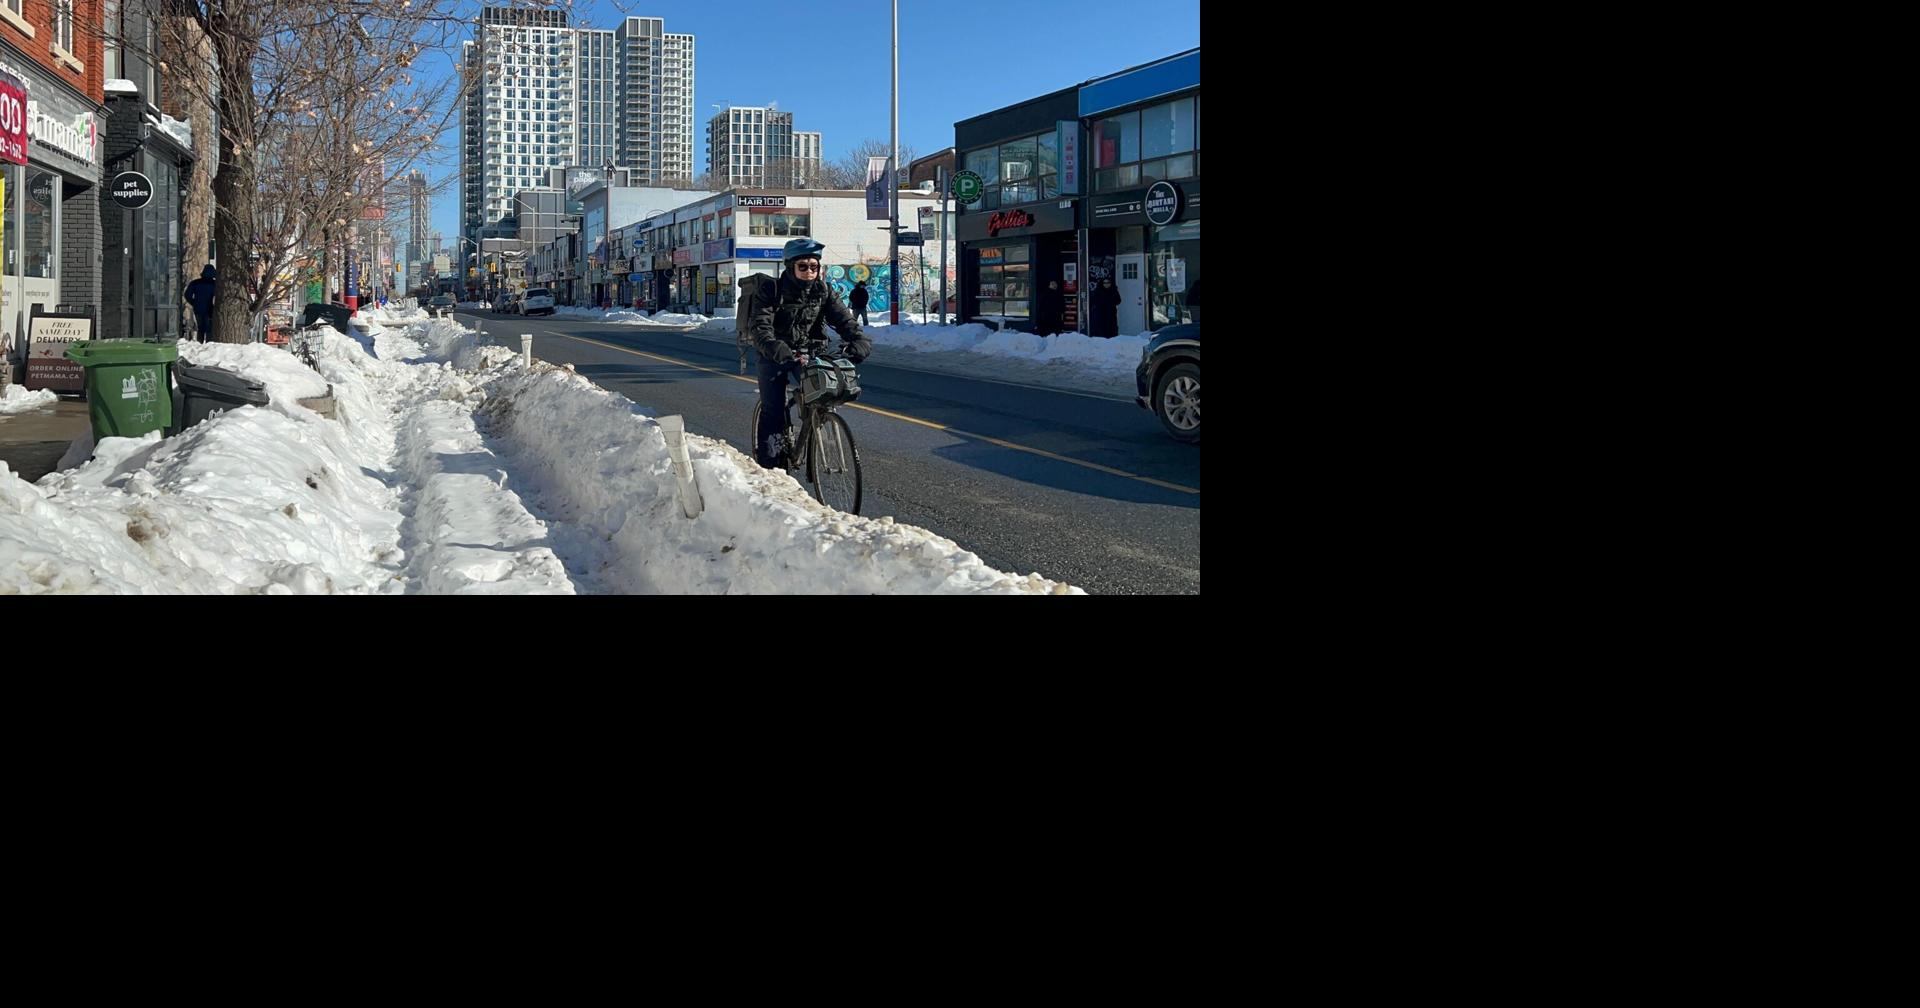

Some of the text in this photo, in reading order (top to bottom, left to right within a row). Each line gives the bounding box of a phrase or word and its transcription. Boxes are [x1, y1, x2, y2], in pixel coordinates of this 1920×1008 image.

[124, 181, 137, 189] pet
[961, 179, 974, 192] P
[113, 189, 148, 198] supplies
